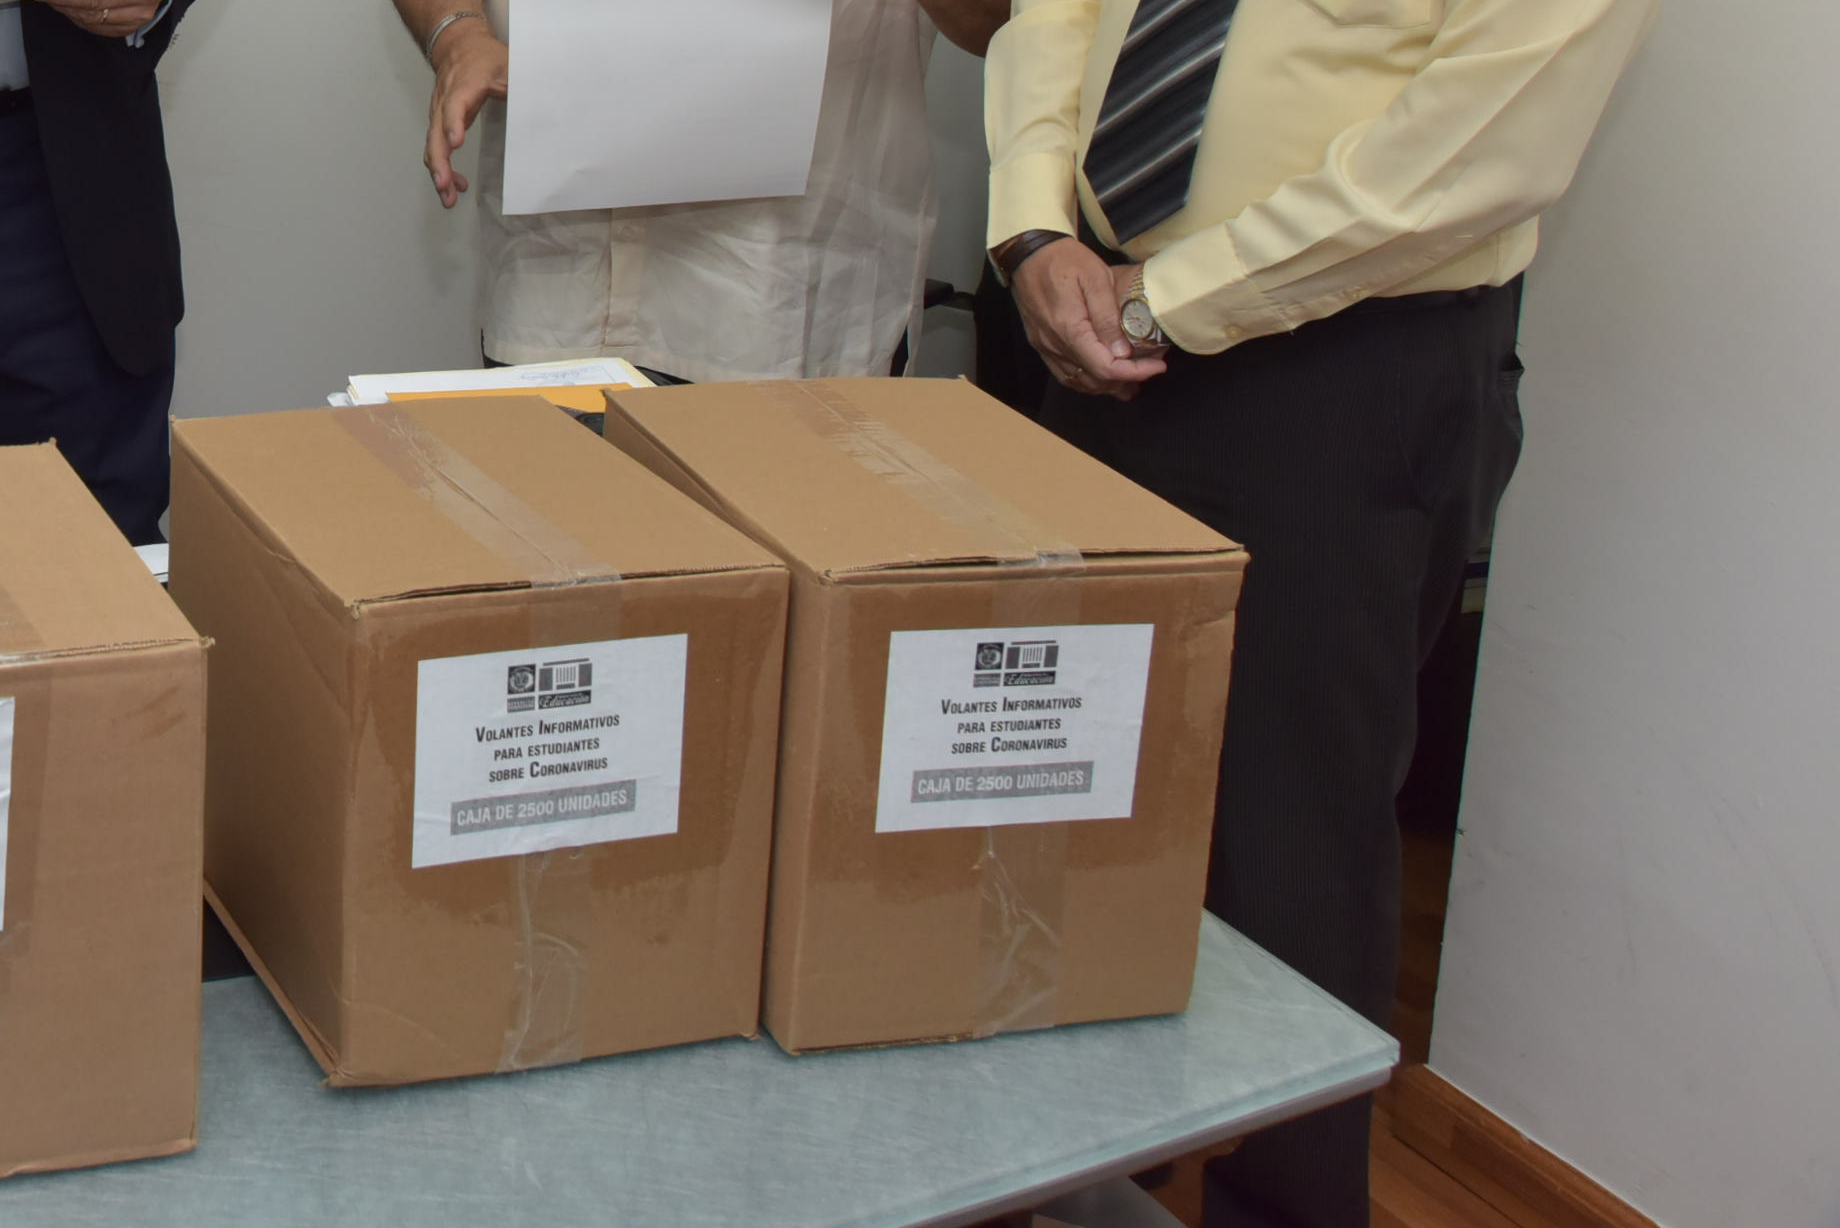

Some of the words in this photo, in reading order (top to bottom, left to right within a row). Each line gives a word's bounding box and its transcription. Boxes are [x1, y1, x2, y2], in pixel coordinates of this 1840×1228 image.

[941, 699, 997, 714] VOLANTES
[1002, 697, 1082, 712] INFORMATIVOS
[476, 725, 533, 743] VOLANTES
[538, 714, 620, 735] INFORMATIVOS
[957, 722, 985, 734] PARA
[990, 718, 1061, 732] ESTUDIANTES
[494, 747, 523, 761] PARA
[528, 738, 600, 756] ESTUDIANTES
[951, 742, 986, 754] SOBRE
[991, 737, 1067, 753] CORONAVIRUS
[489, 768, 524, 783] SOBRE
[530, 757, 608, 778] CORONAVIRUS
[918, 778, 951, 794] CAJA
[955, 777, 973, 792] DE
[976, 775, 1013, 791] 2500
[1016, 770, 1084, 789] UNIDADES
[457, 809, 491, 826] CAJA
[496, 805, 514, 819] DE
[518, 801, 554, 818] 2500
[558, 789, 627, 812] UNIDADES
